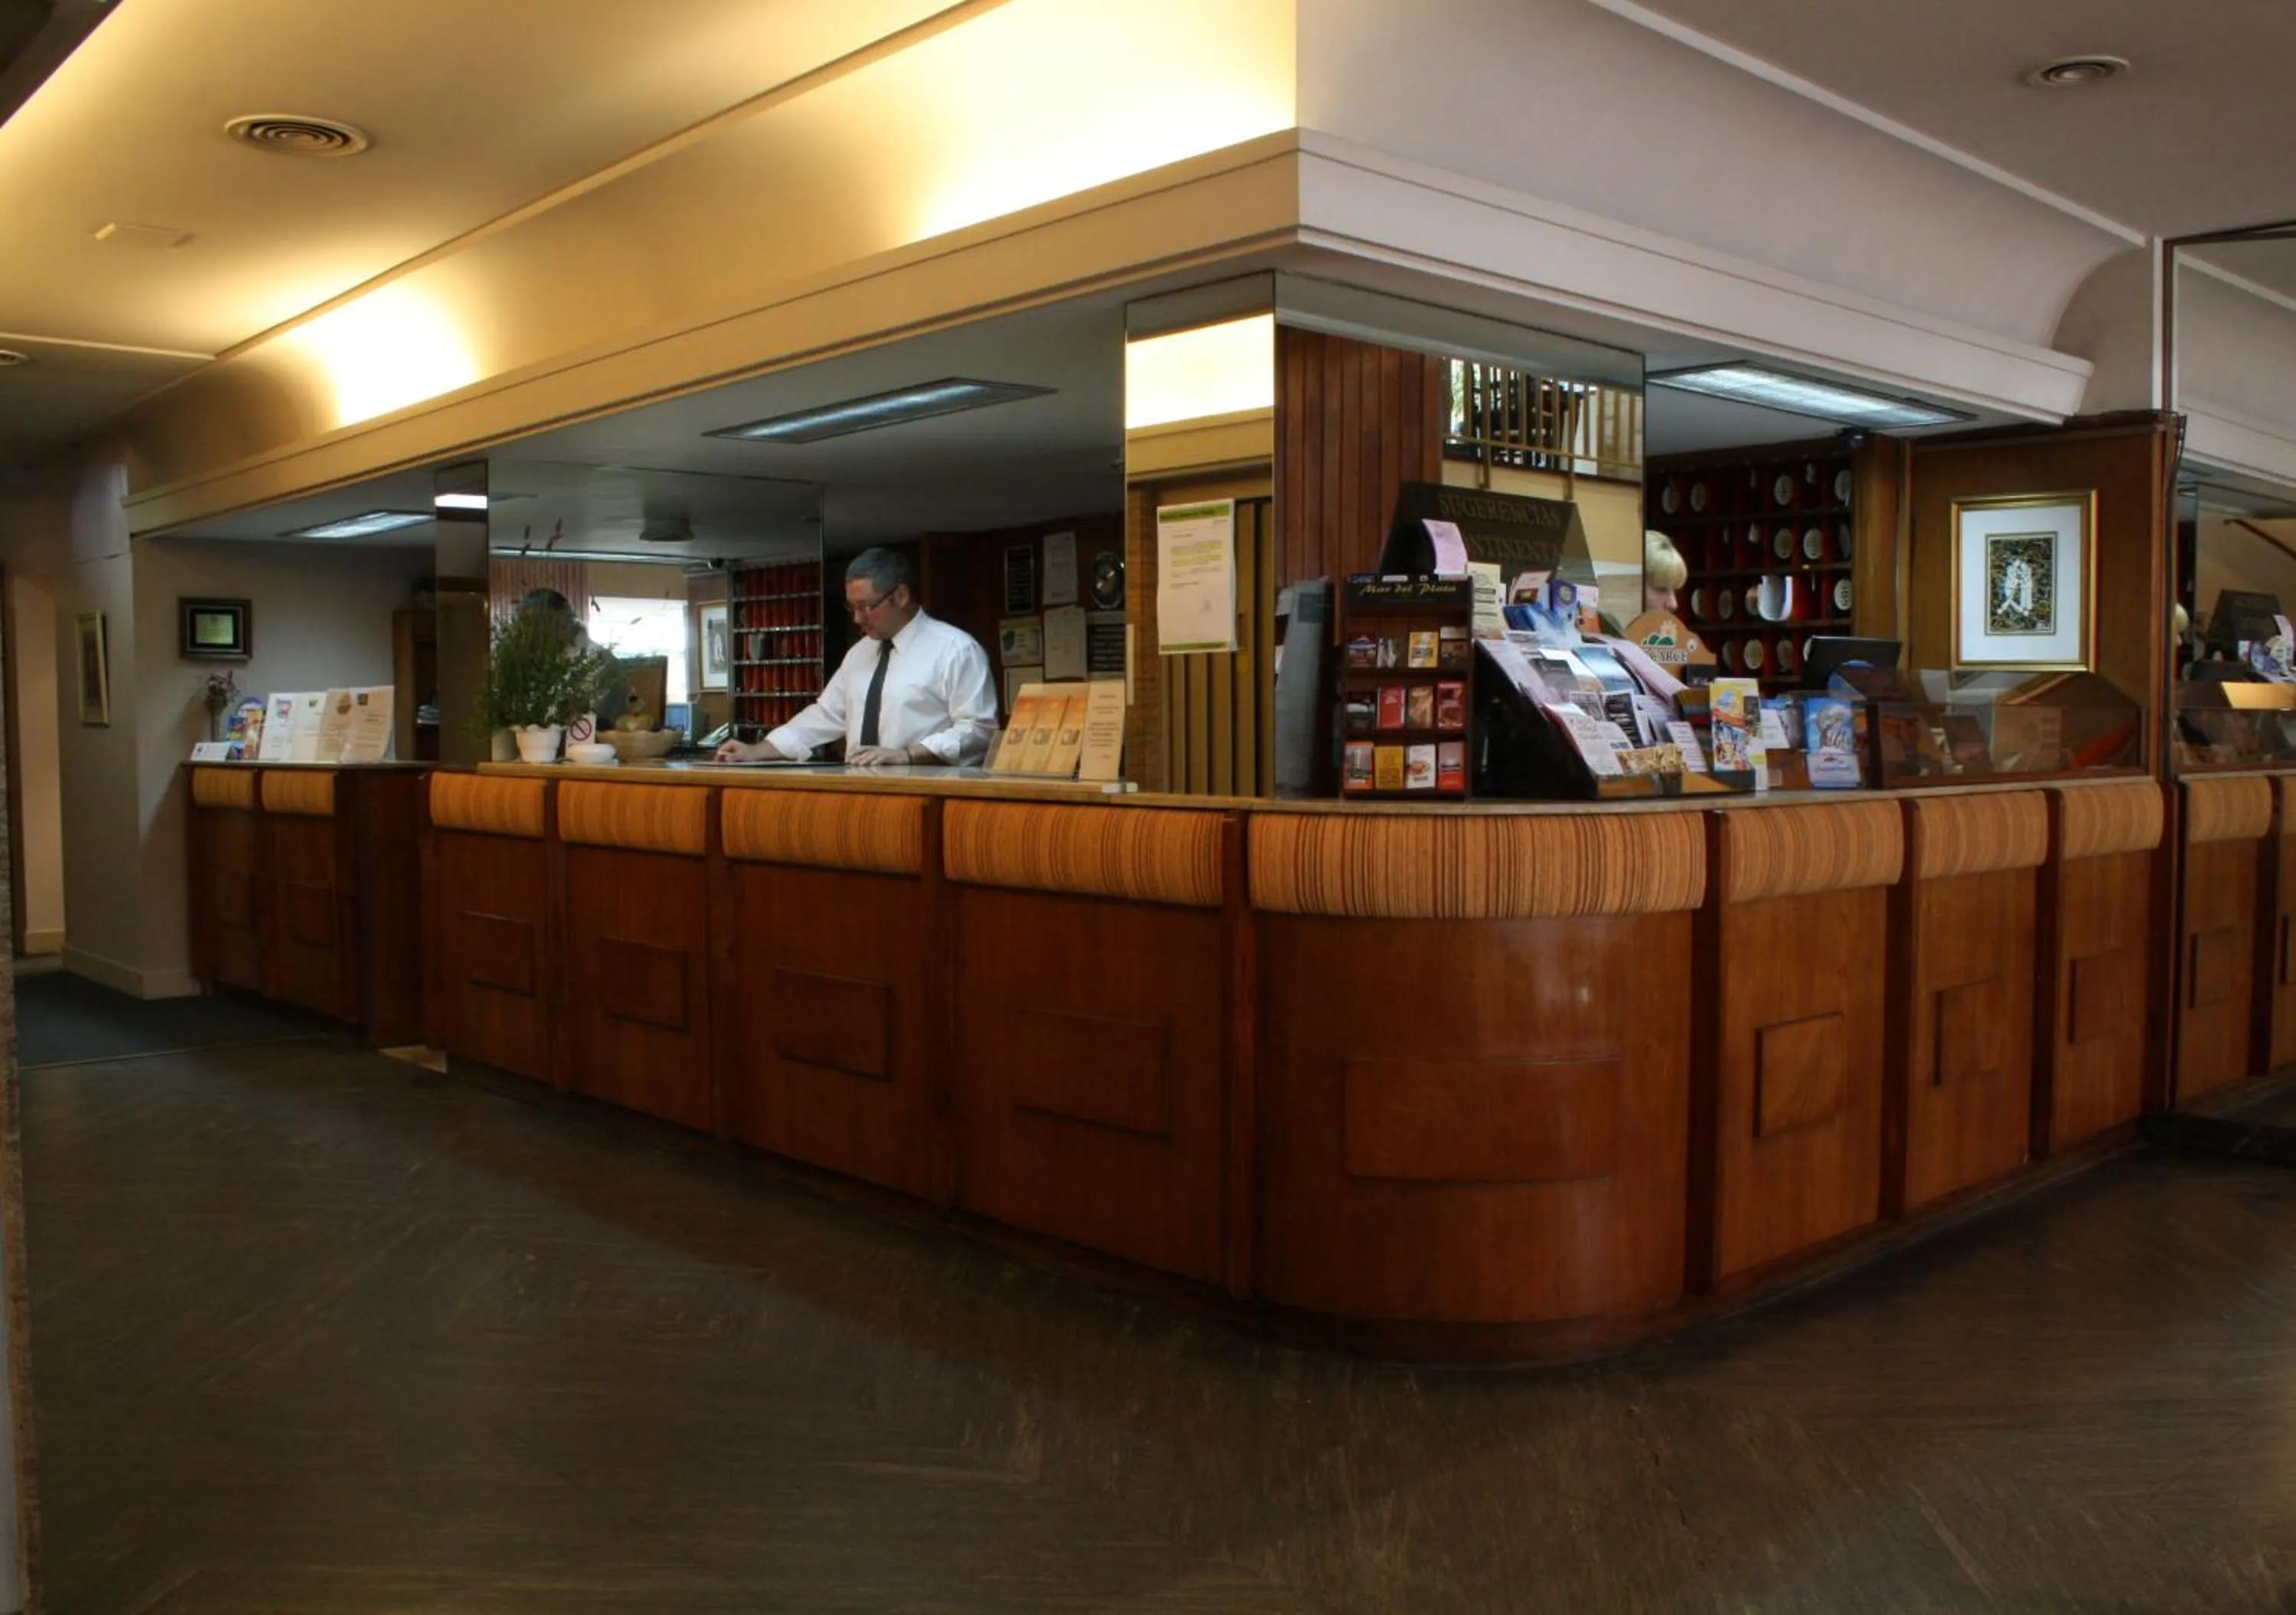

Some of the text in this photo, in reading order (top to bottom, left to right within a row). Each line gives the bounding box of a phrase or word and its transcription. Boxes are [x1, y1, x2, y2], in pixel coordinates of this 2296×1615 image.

[1437, 493, 1561, 527] SUGERENCIAS
[1358, 582, 1457, 596] Mar del Plata
